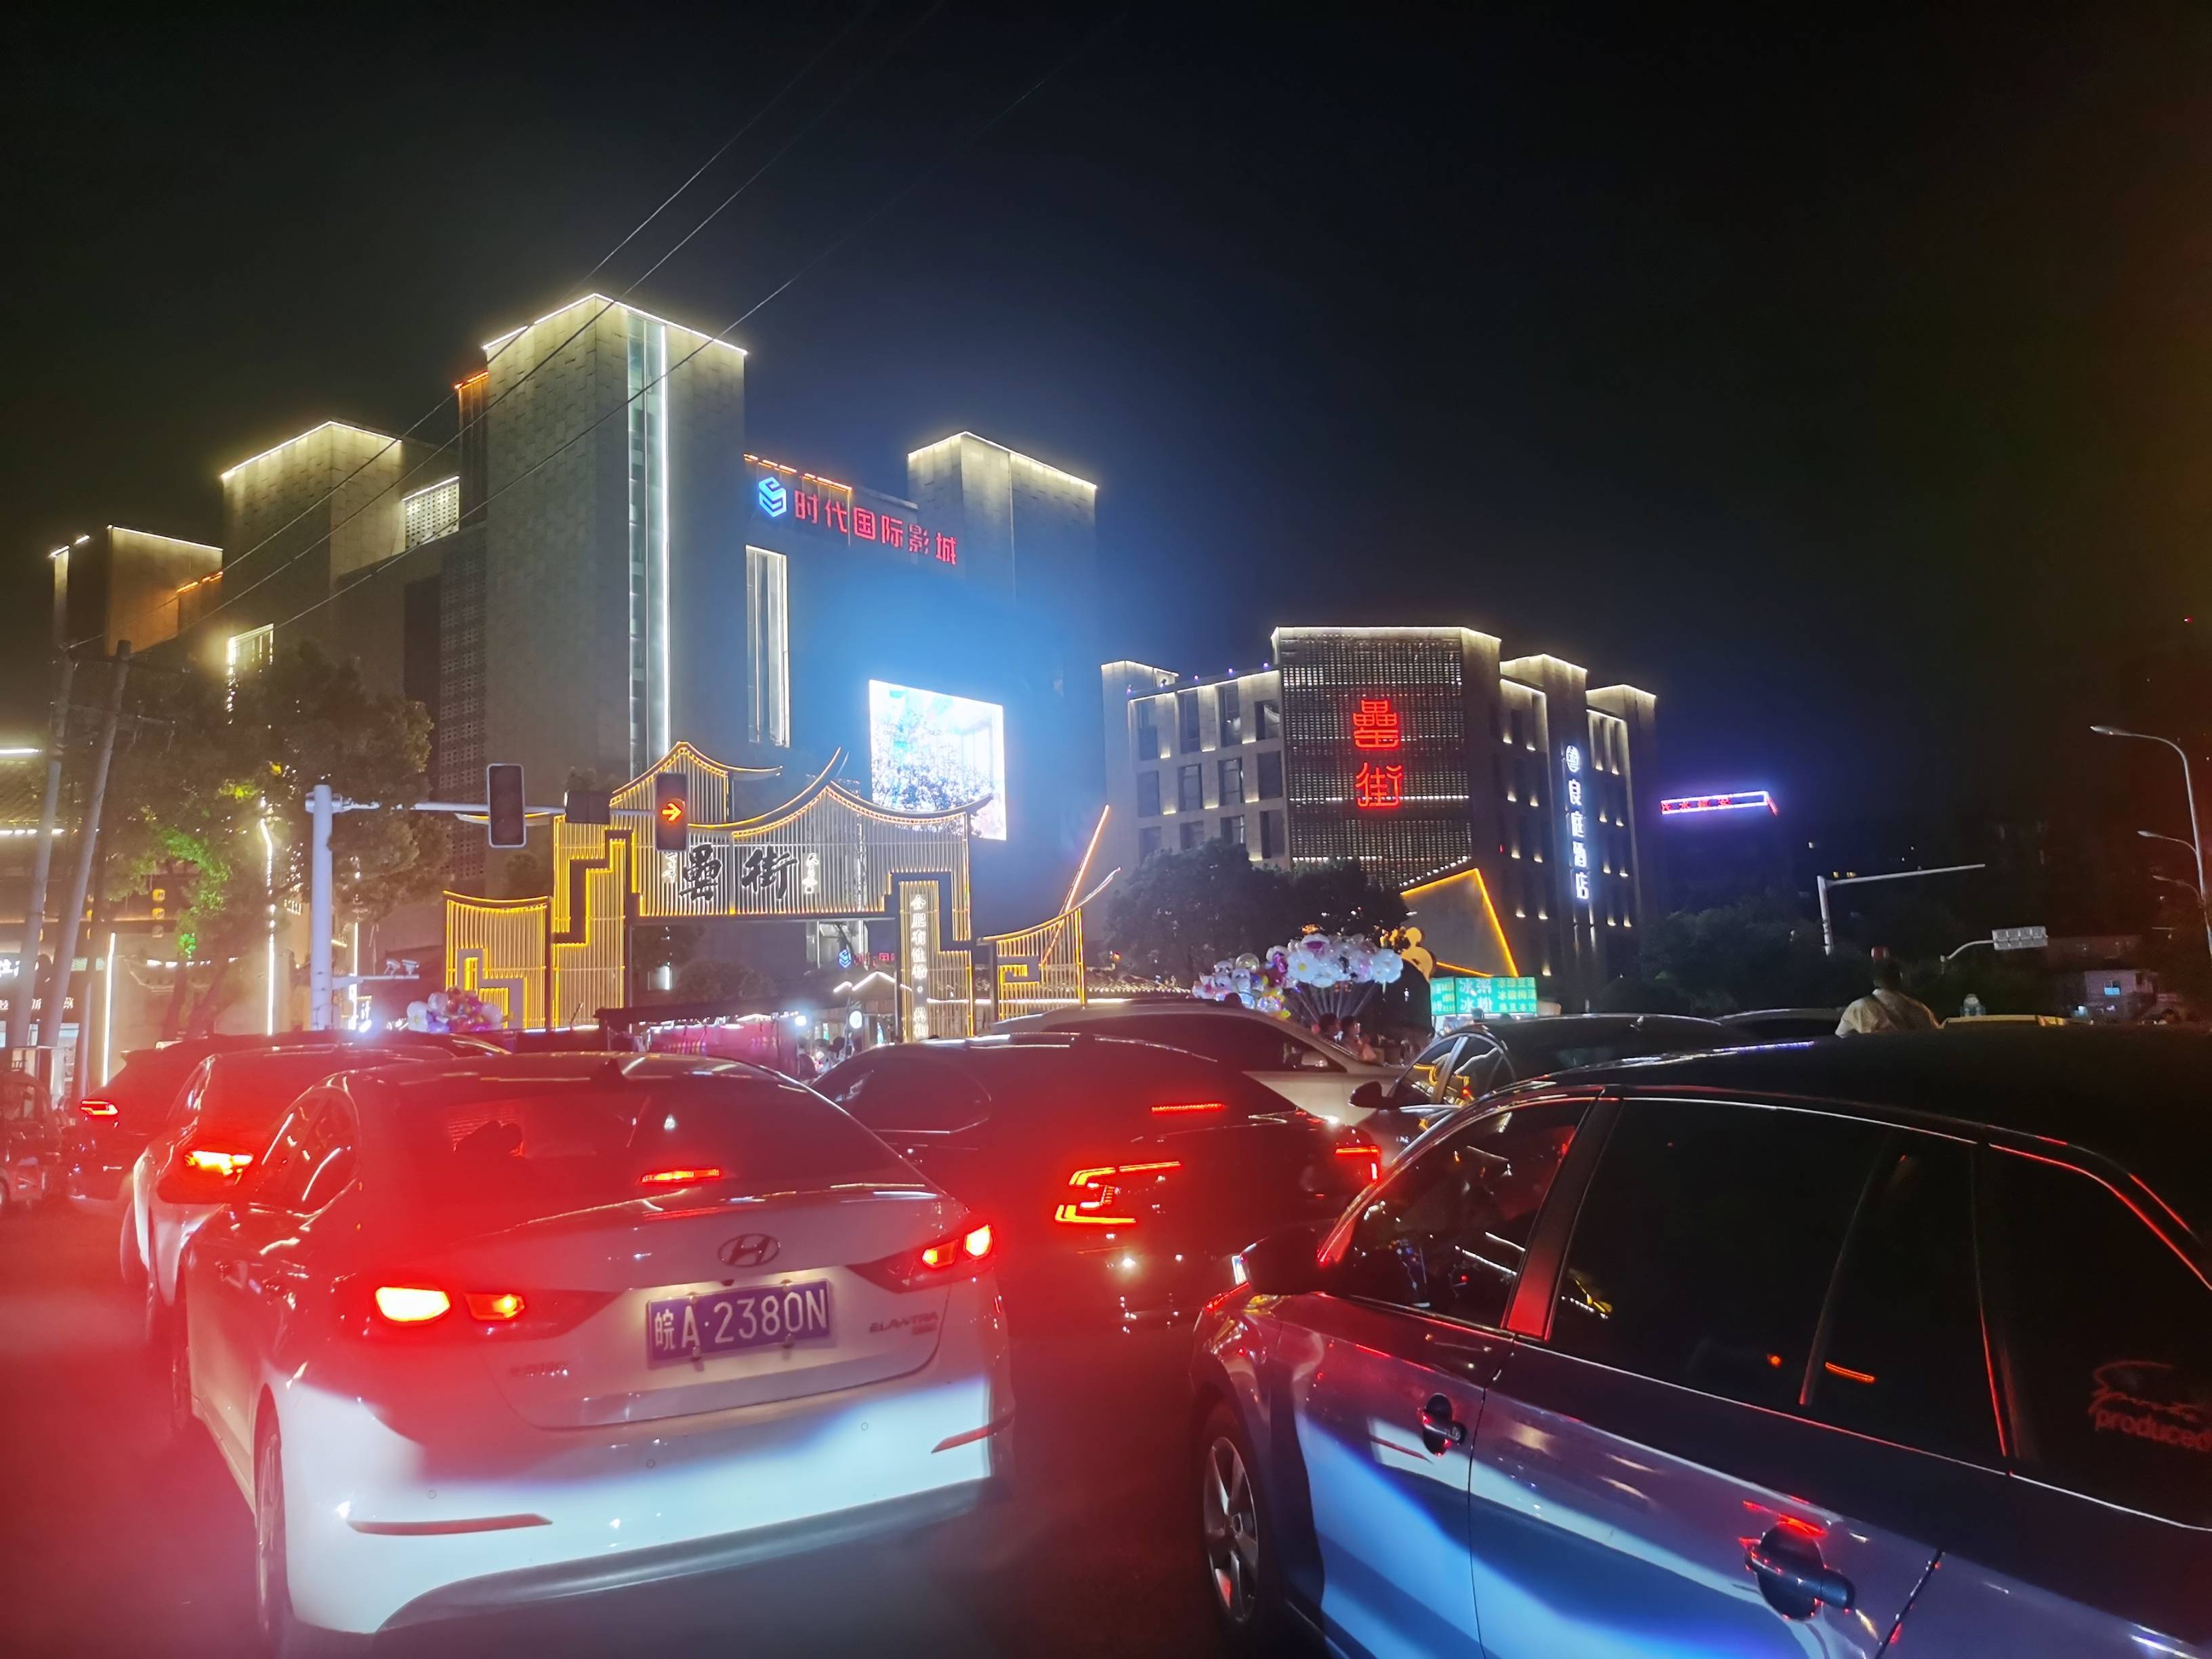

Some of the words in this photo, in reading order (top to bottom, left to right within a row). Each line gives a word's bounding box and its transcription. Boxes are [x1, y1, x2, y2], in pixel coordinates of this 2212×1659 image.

[794, 489, 957, 565] 时代国际影城
[654, 1288, 827, 1351] 皖A·2380N
